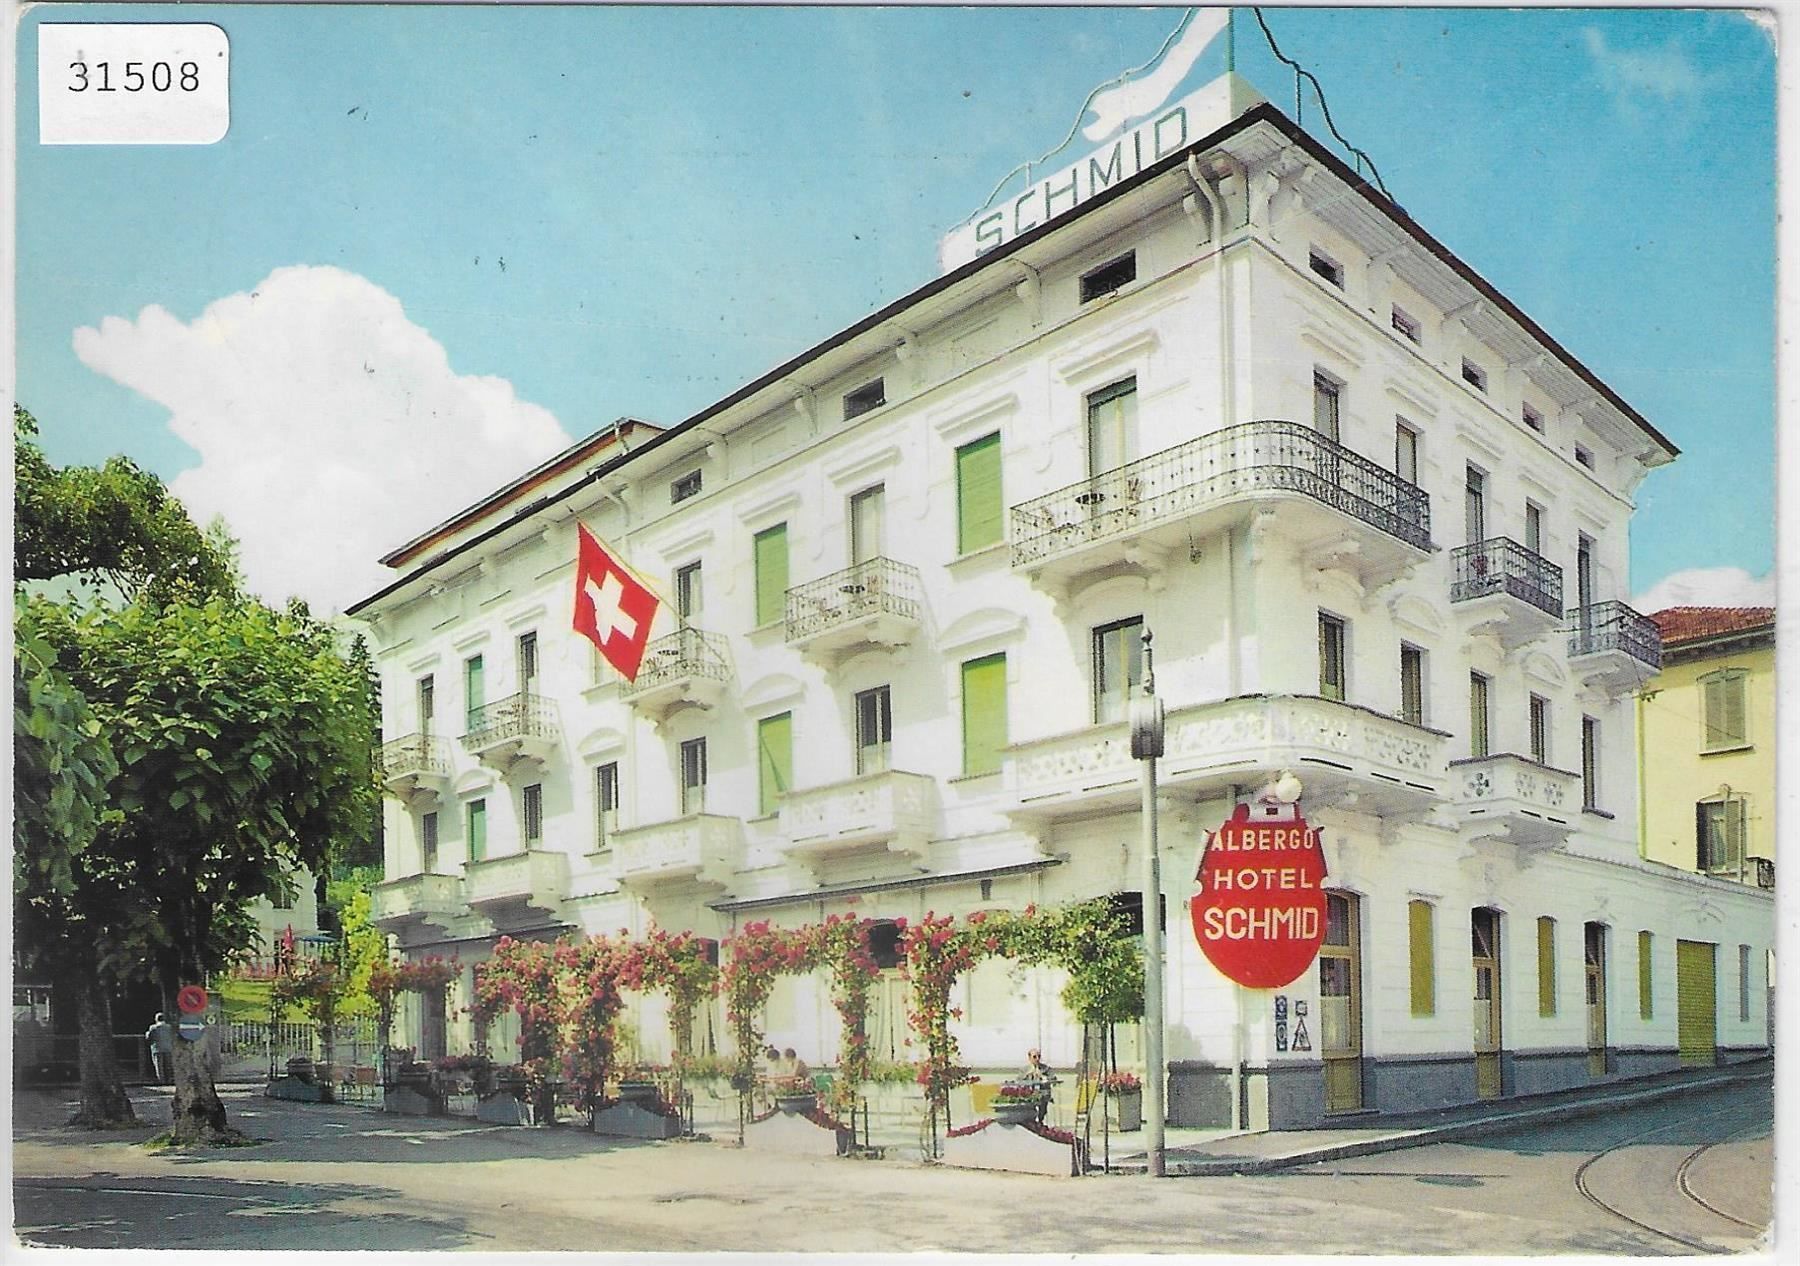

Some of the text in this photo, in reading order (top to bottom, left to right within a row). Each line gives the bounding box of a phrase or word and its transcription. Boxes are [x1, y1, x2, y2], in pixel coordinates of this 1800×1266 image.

[975, 106, 1187, 258] SCHMID
[1211, 829, 1314, 851] ALBERGO
[1213, 868, 1313, 890] HOTEL
[1204, 906, 1319, 940] SCHMID
